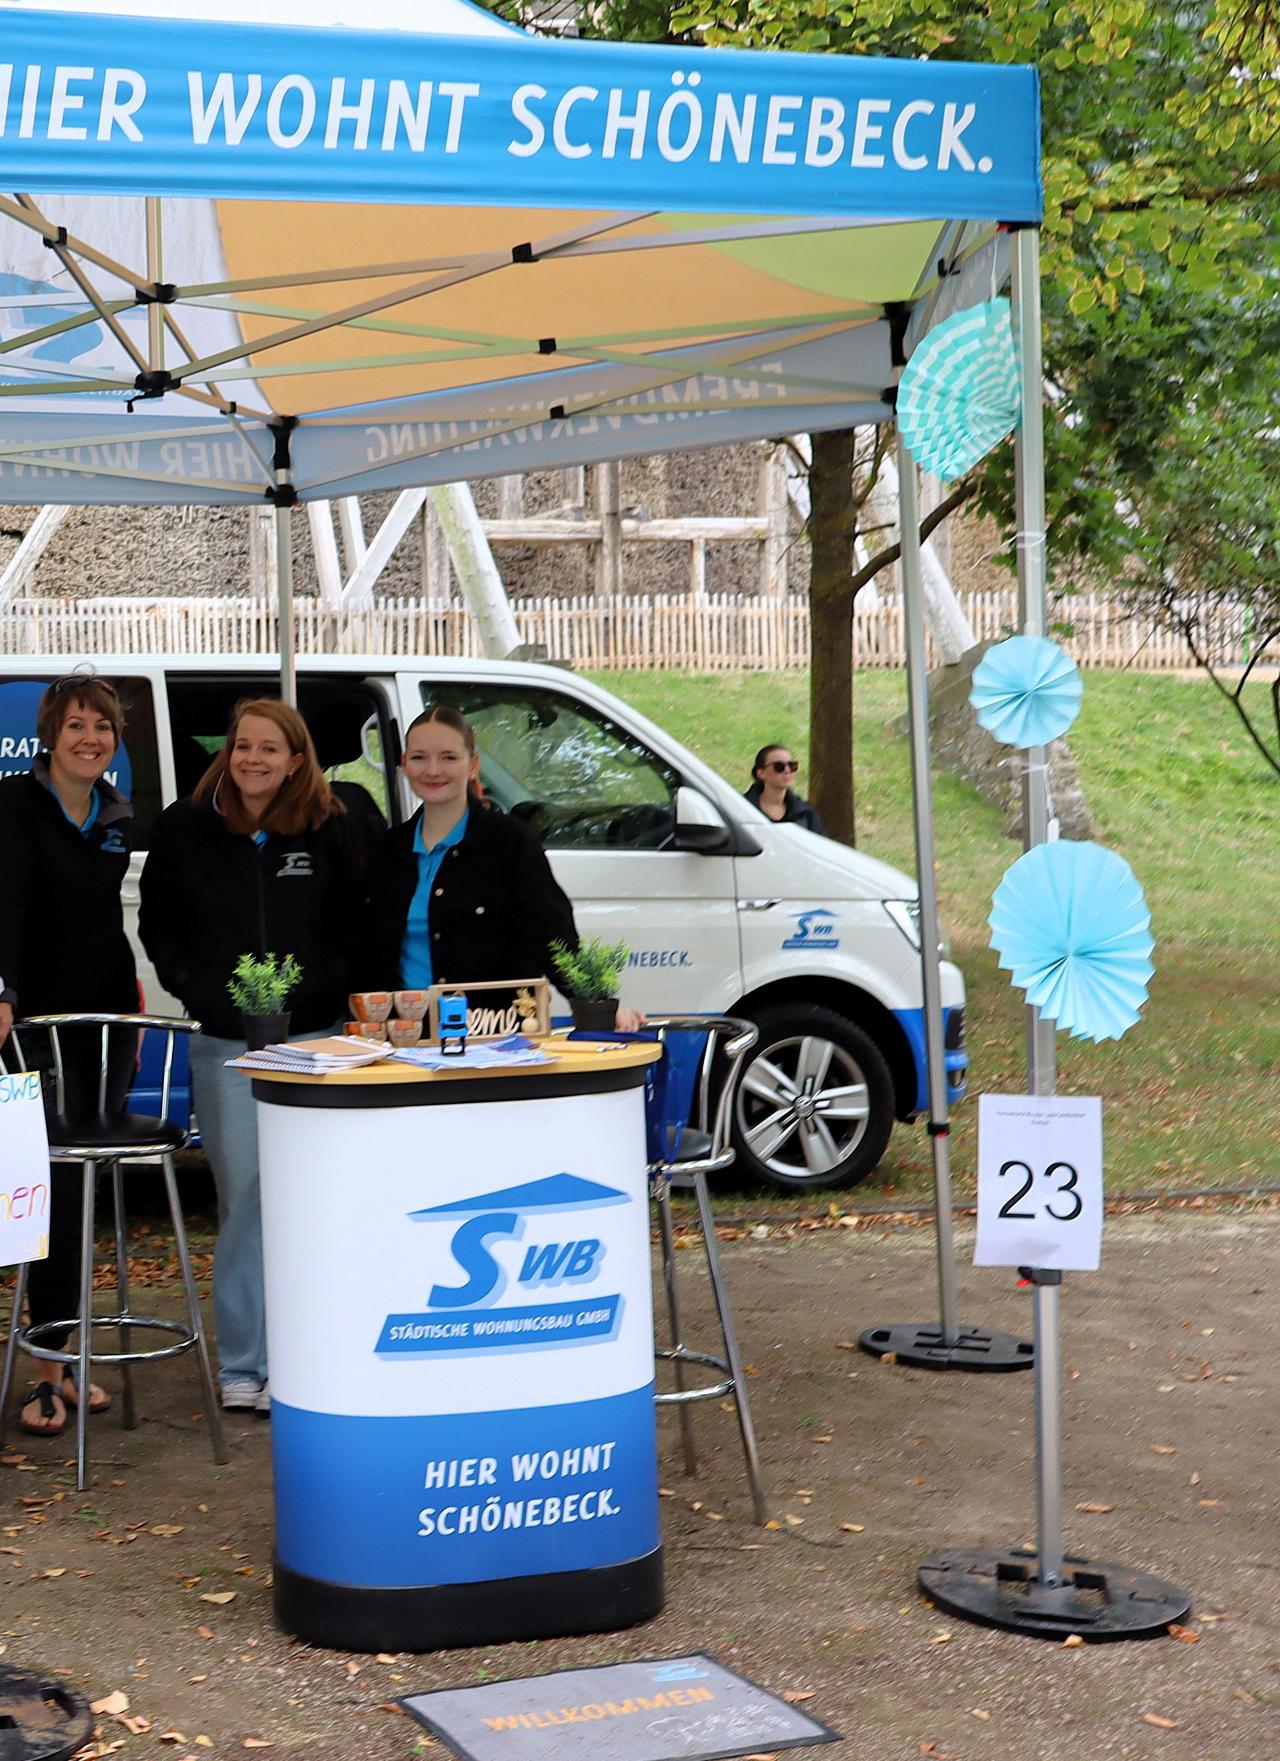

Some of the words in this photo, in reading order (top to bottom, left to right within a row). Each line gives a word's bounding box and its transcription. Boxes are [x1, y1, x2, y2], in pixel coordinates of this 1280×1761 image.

[188, 70, 479, 152] WOHNT
[507, 71, 993, 174] SCHÖNEBECK.
[628, 950, 694, 968] NEBECK.
[997, 1160, 1083, 1221] 23
[427, 1212, 602, 1308] SWB
[389, 1322, 469, 1340] STÄDTISCHE
[473, 1314, 574, 1336] WOHNUNGSBAU
[424, 1456, 498, 1490] HIER
[512, 1442, 617, 1483] WOHNT
[418, 1487, 622, 1538] SCHÖNEBECK.
[483, 1686, 714, 1732] WILLKOMMEN
